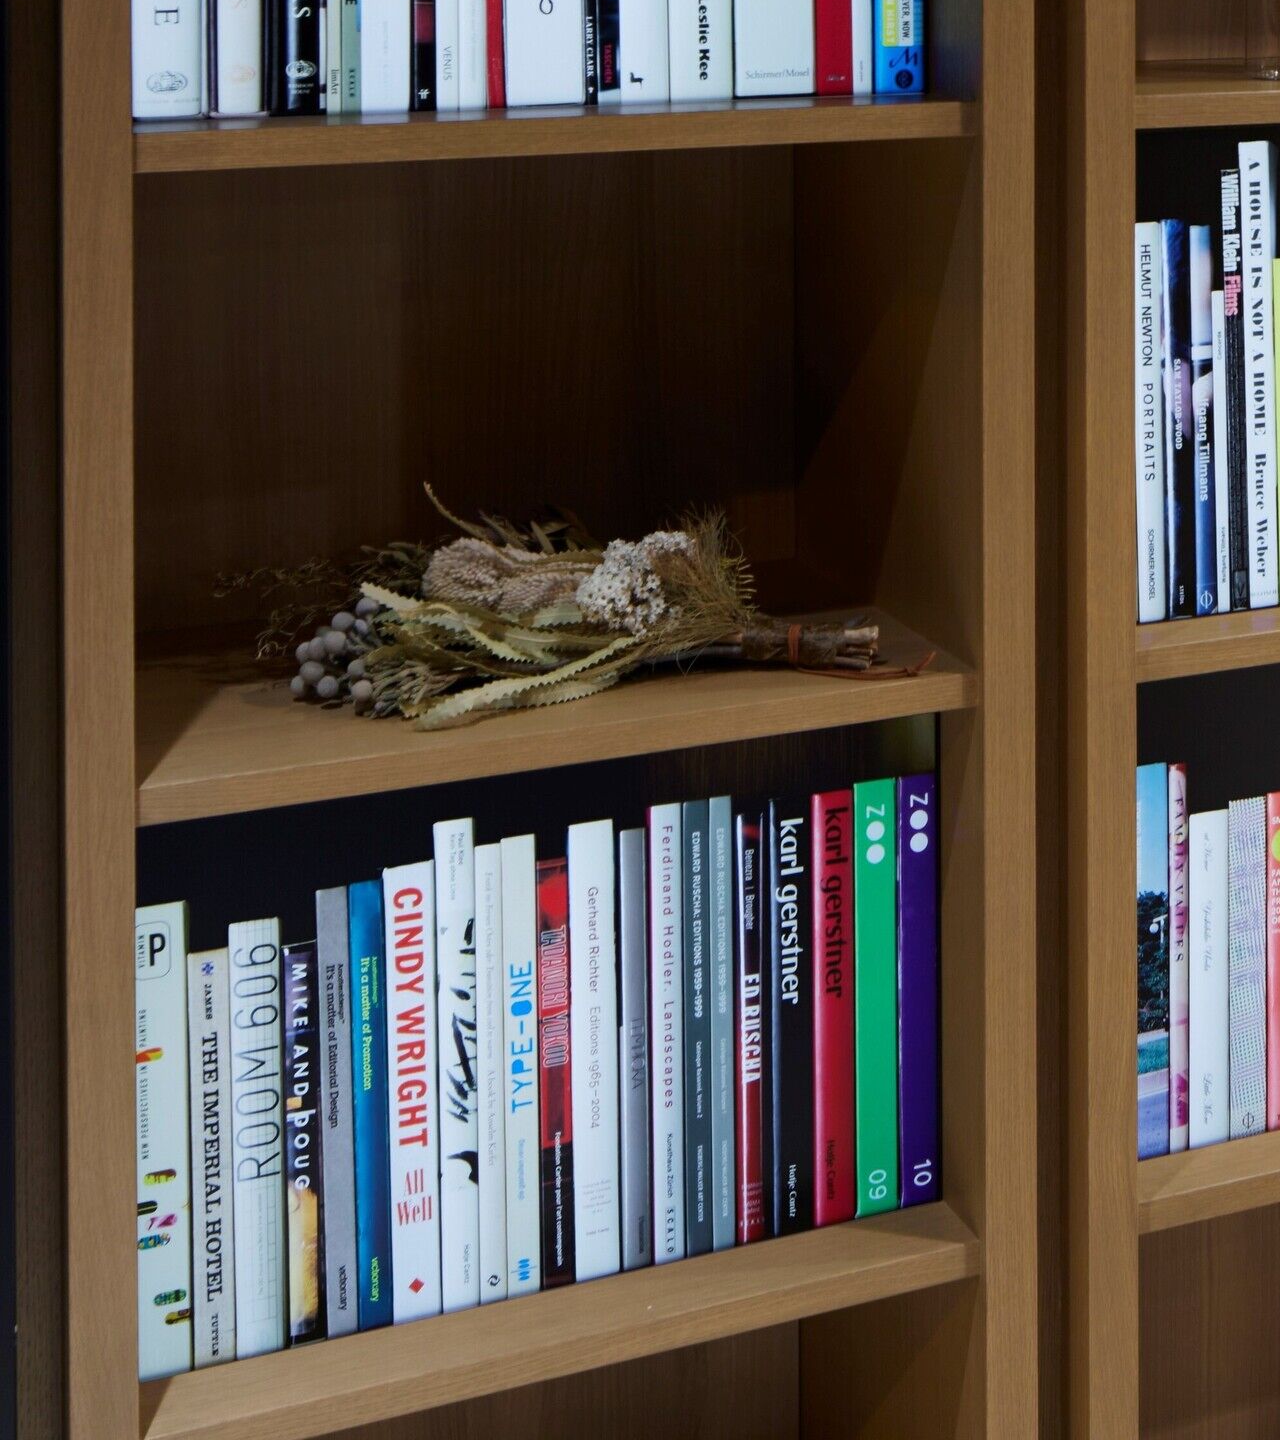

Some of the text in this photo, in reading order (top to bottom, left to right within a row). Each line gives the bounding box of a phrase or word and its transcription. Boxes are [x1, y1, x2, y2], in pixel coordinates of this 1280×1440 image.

[442, 46, 453, 80] VENUS
[585, 16, 594, 77] LARRY CLARK
[603, 43, 613, 83] TASCHEN
[698, 48, 710, 80] Kee
[902, 20, 910, 41] NOW.
[1139, 244, 1155, 366] HELMUT NEWTON
[1222, 173, 1242, 316] William Klein Films
[1248, 158, 1267, 436] A HOUSE IS NOT A HOME
[1142, 383, 1157, 482] PORTRAITS
[1252, 454, 1270, 576] Bruce Weber
[586, 887, 601, 993] Gerhard Richter
[776, 817, 803, 1005] karl gerstner
[820, 807, 848, 999] karl gerstner
[394, 888, 428, 1148] CINDY WRIGHT
[661, 826, 676, 1109] Ferdinand Hodler. Landscapes
[233, 944, 281, 1183] ROOM 606
[509, 963, 532, 1113] TYPE-ONE
[201, 1032, 224, 1302] THE IMPERIAL HOTEL
[868, 1169, 887, 1201] 09
[913, 1159, 932, 1186] 10
